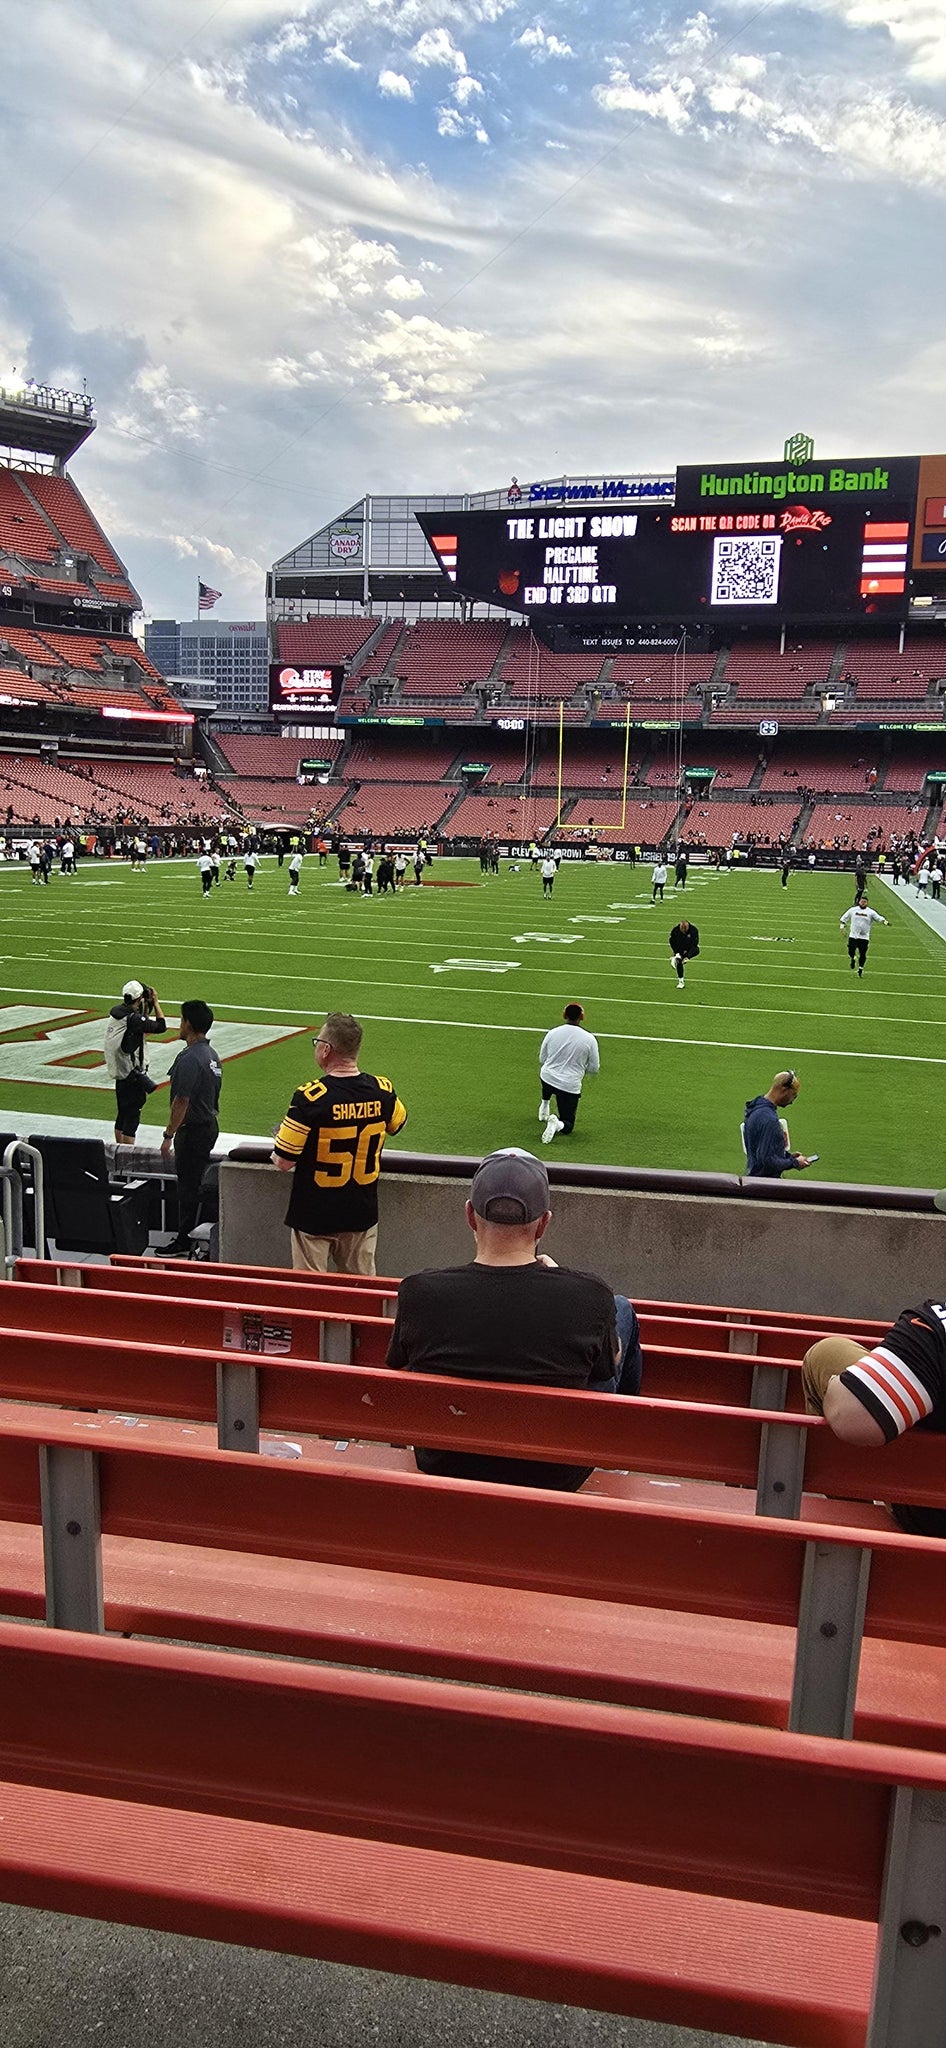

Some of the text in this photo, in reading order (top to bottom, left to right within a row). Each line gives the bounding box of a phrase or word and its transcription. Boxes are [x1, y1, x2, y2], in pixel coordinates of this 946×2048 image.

[701, 467, 889, 499] Huntington Bank
[507, 515, 638, 539] THE LIGHT SHOW
[671, 514, 776, 531] SCAN THE QR CODE OR
[545, 545, 598, 564] PREGAME
[543, 566, 599, 584] HALFTIME
[2, 586, 12, 596] 49
[524, 585, 617, 604] END OF 3RD QTR
[763, 722, 776, 734] 25
[333, 1101, 382, 1120] SHAZIER
[314, 1121, 387, 1188] 50
